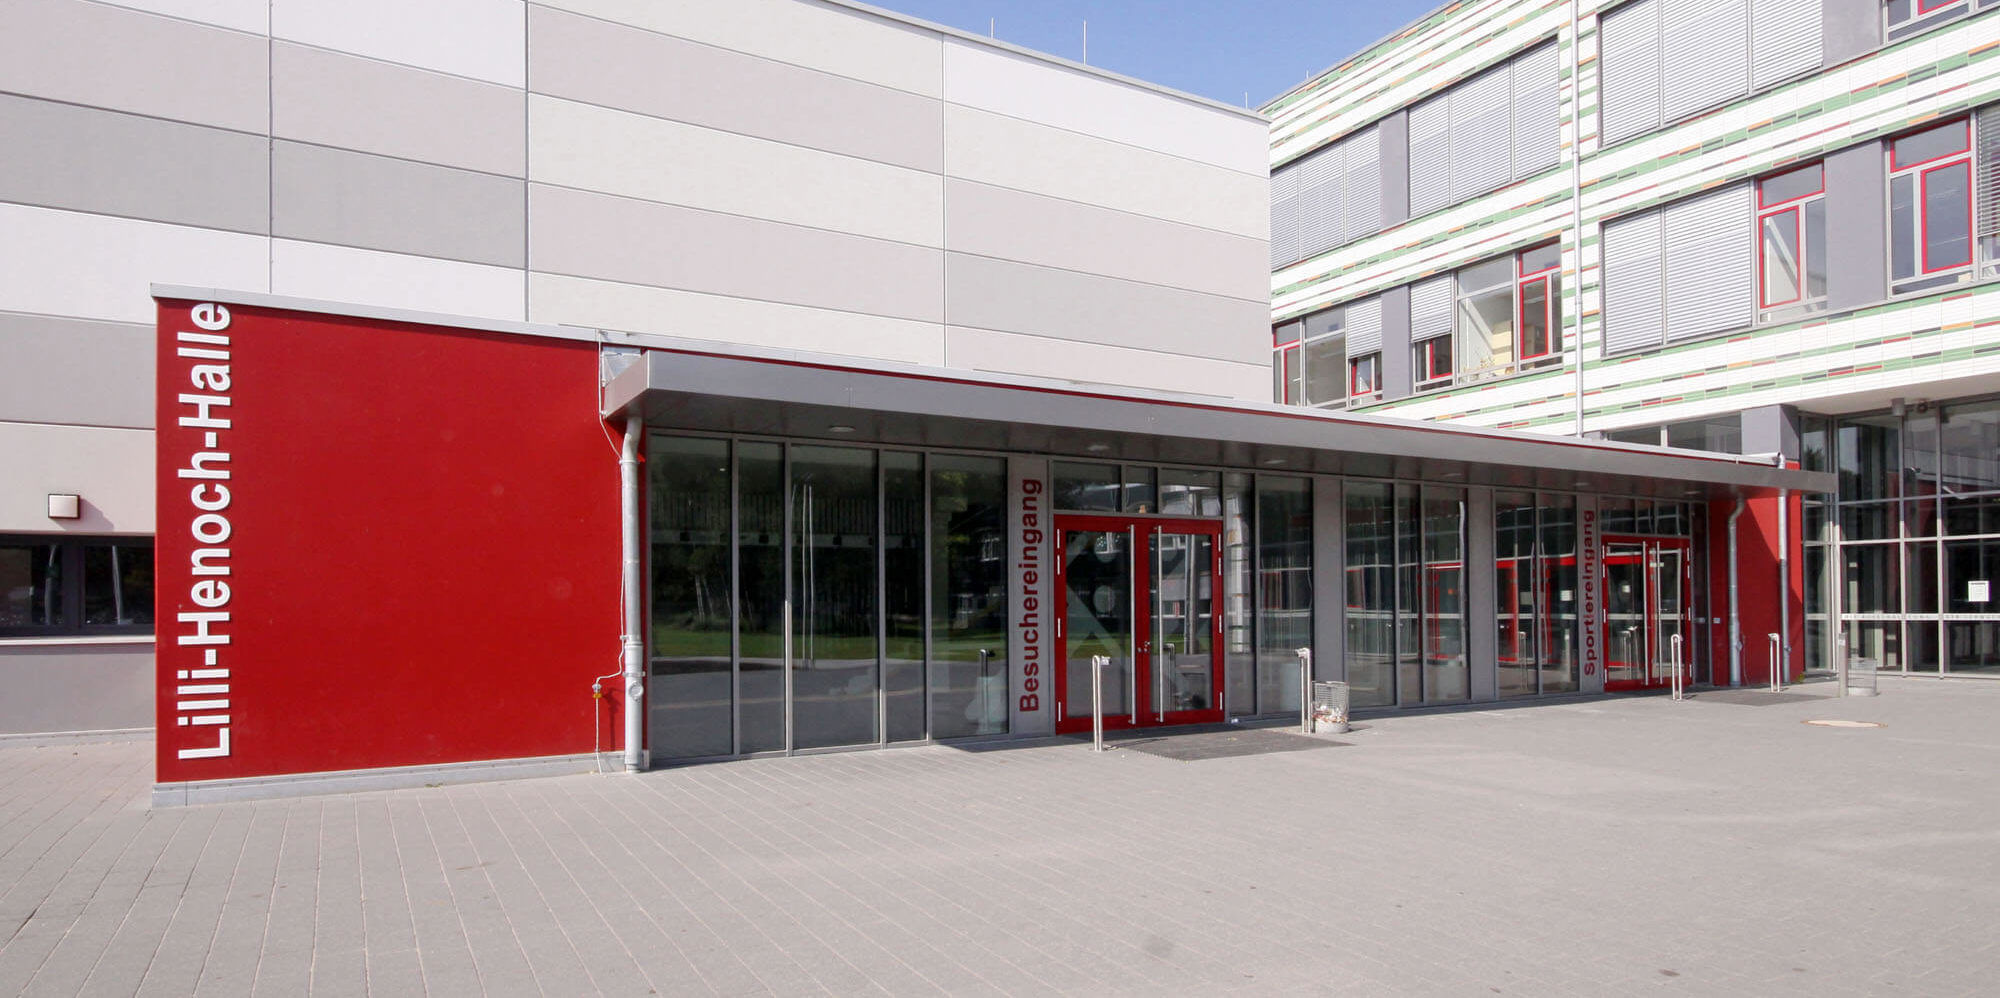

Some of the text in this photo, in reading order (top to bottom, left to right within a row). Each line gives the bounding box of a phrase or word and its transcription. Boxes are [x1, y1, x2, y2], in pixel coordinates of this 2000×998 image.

[177, 302, 232, 760] Lilli-Henoch-Halle
[1018, 478, 1043, 712] Besuchereingang
[1583, 510, 1597, 676] Sportlereingang
